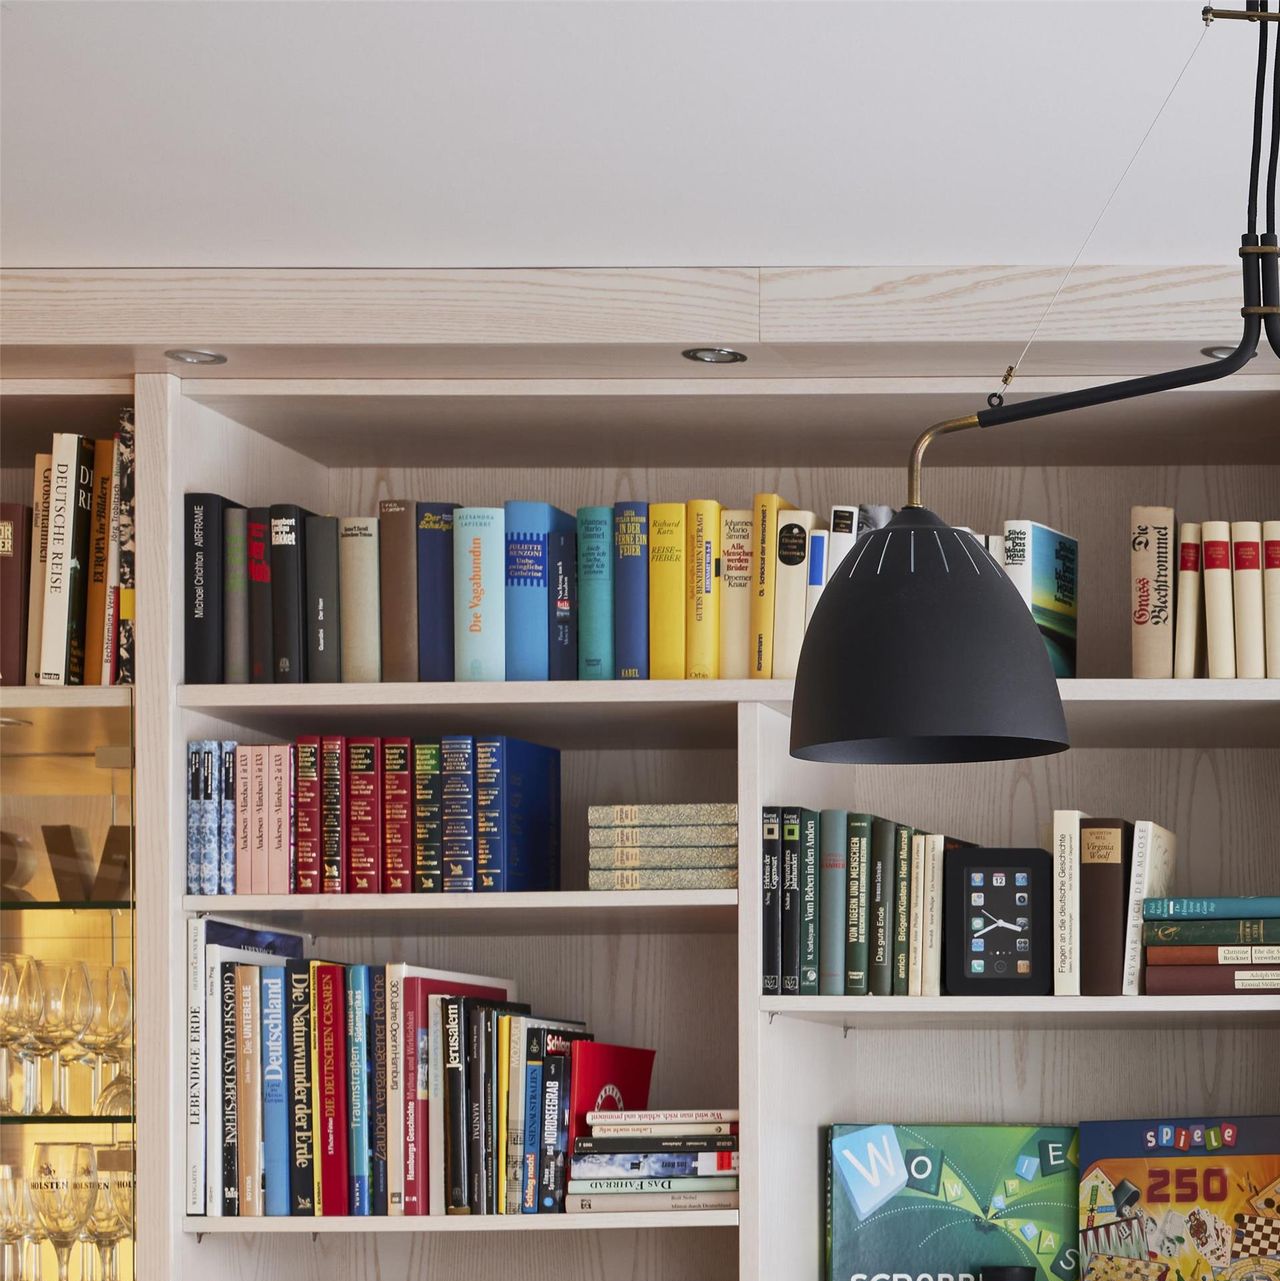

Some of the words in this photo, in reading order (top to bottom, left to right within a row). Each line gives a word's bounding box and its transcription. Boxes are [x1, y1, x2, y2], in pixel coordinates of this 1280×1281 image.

[52, 464, 69, 546] DEUTSCHE
[111, 526, 119, 542] Jörg
[195, 505, 204, 547] AIRFRAME
[652, 520, 680, 528] Richard
[1132, 525, 1150, 552] Die
[50, 552, 64, 594] REISE
[195, 551, 204, 583] Crichton
[469, 537, 484, 606] Vagabundin
[651, 554, 681, 562] FIEBER
[1151, 526, 1169, 626] Blechtrommel
[106, 585, 116, 609] Verlag
[195, 584, 204, 618] Michael
[469, 613, 482, 633] Die
[806, 821, 814, 847] Anden
[899, 830, 907, 859] Munzel
[1086, 842, 1114, 851] Virginia
[806, 849, 814, 864] den
[850, 837, 859, 878] MENSCHEN
[899, 860, 907, 877] Herr
[806, 875, 814, 900] Beben
[850, 881, 858, 895] UND
[994, 877, 1004, 885] 12
[806, 902, 814, 921] Vom
[849, 898, 858, 924] TIGERN
[876, 907, 884, 926] Ende
[898, 881, 908, 941] Bröger/Küsters
[849, 927, 858, 942] VON
[877, 928, 885, 945] gute
[1060, 934, 1066, 943] an
[898, 954, 906, 978] anrich
[1059, 945, 1067, 973] Fragen
[291, 973, 308, 1002] Die
[373, 974, 385, 1019] Reiche
[223, 973, 236, 1034] GROSSER
[243, 985, 252, 1038] UNTERELBE
[190, 1006, 200, 1043] ERDE
[263, 978, 282, 1080] Deutschland
[445, 1004, 462, 1071] Jerusalem
[224, 1036, 236, 1073] ATLAS
[292, 1003, 310, 1103] Naturwunder
[375, 1023, 386, 1109] vergangener
[190, 1048, 201, 1125] LEBENDIGE
[350, 1046, 362, 1128] Traumstraßen
[293, 1105, 310, 1129] der
[406, 1101, 415, 1141] Geschichte
[544, 1081, 559, 1144] NORDSEEGRAB
[295, 1131, 311, 1168] Erde
[375, 1112, 387, 1160] Zauber
[406, 1143, 417, 1180] Hamburgs
[590, 1181, 644, 1190] FAHRRAD
[648, 1180, 671, 1189] DAS
[1146, 1168, 1228, 1203] 250
